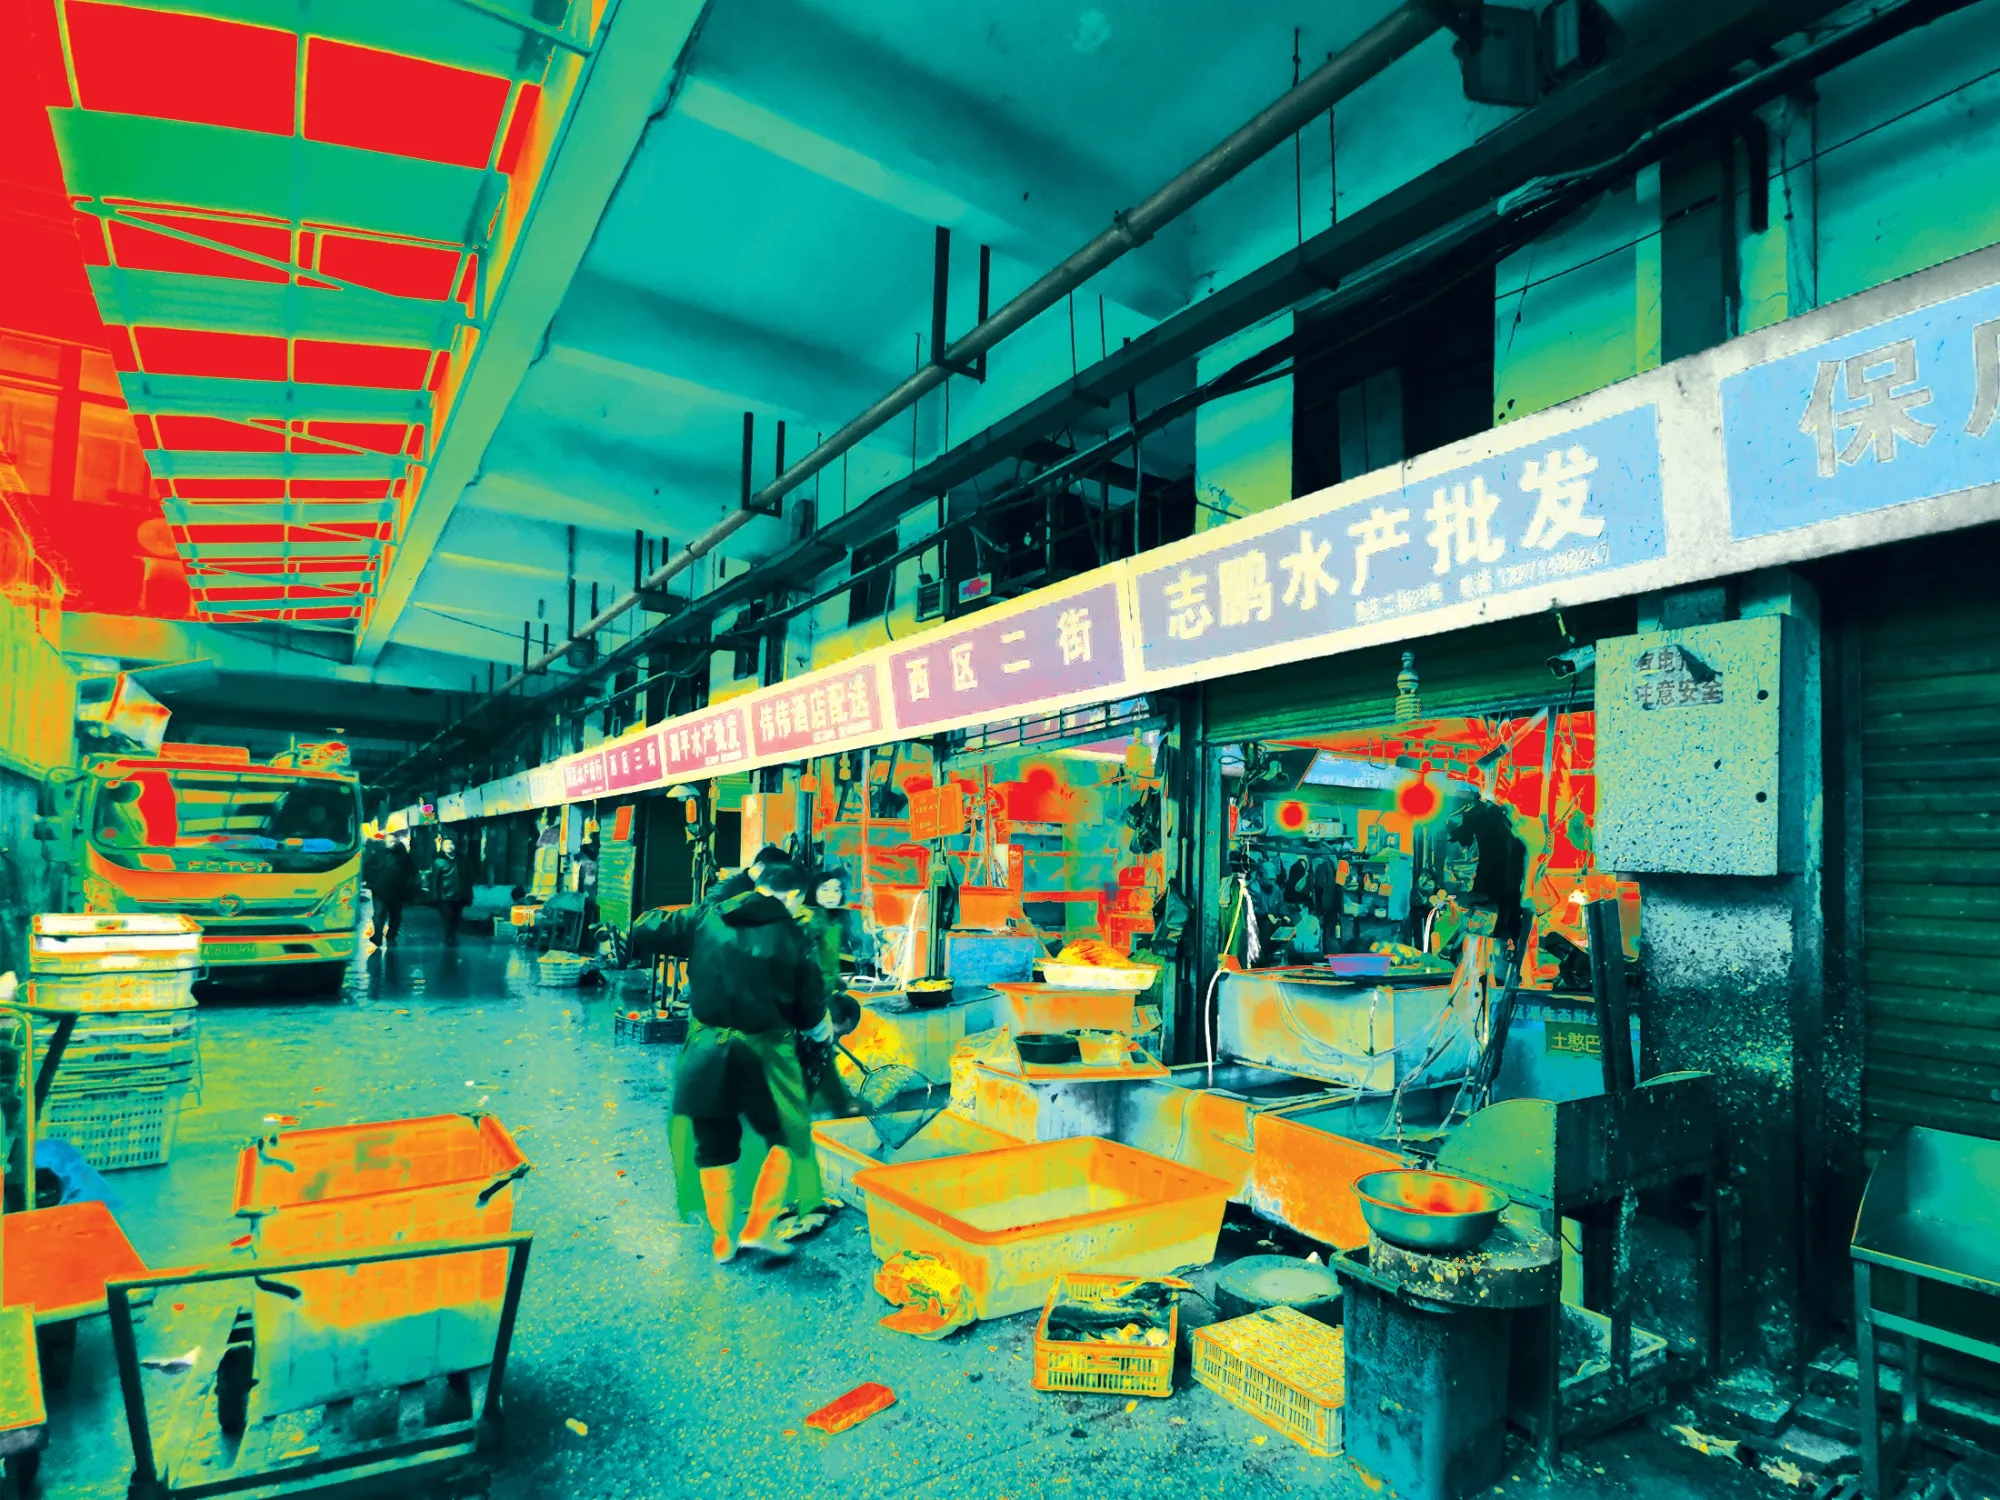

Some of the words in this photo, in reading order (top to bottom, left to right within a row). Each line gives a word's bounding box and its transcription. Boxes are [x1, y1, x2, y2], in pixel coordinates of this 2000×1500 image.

[1163, 444, 1607, 641] 志鹏水产批发
[905, 607, 1092, 702] 西区二街
[1635, 677, 1724, 706] 注意安全
